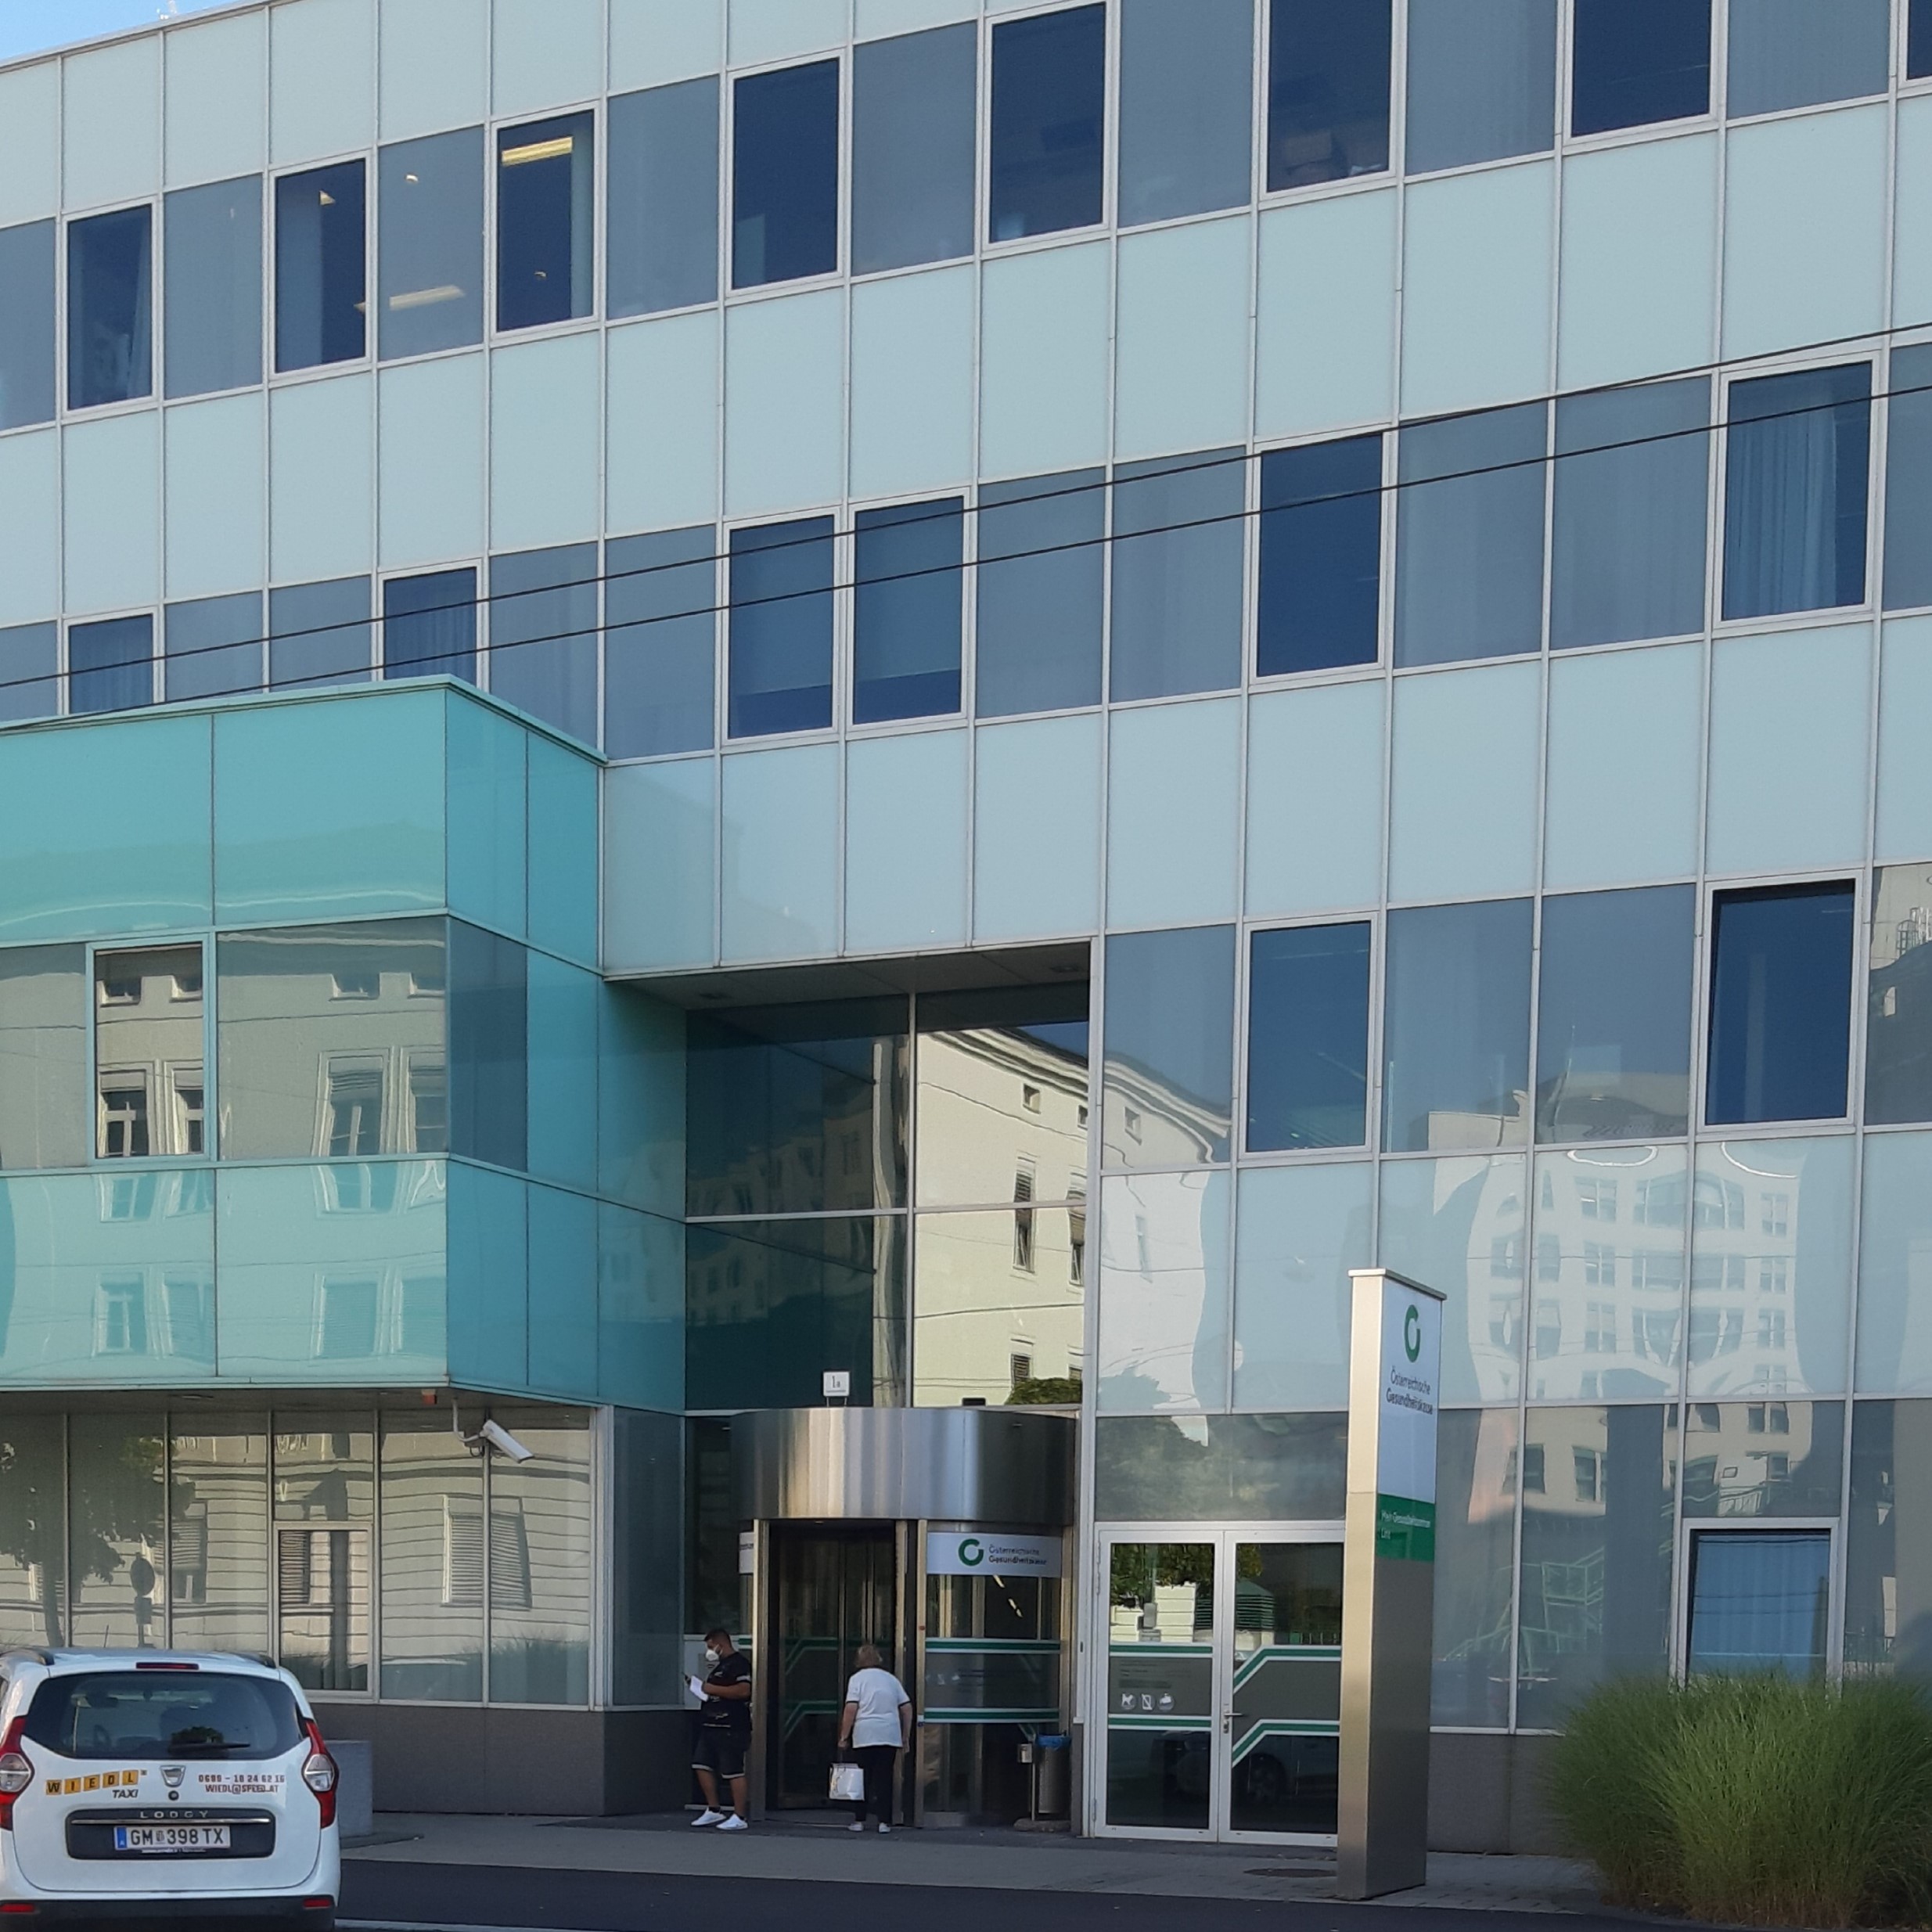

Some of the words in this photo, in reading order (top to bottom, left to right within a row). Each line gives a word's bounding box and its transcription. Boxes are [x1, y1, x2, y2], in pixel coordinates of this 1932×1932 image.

[47, 1771, 137, 1793] WIEDL
[112, 1789, 139, 1798] TAXI
[131, 1829, 153, 1845] GM
[167, 1829, 199, 1844] 398
[203, 1828, 224, 1844] TX
